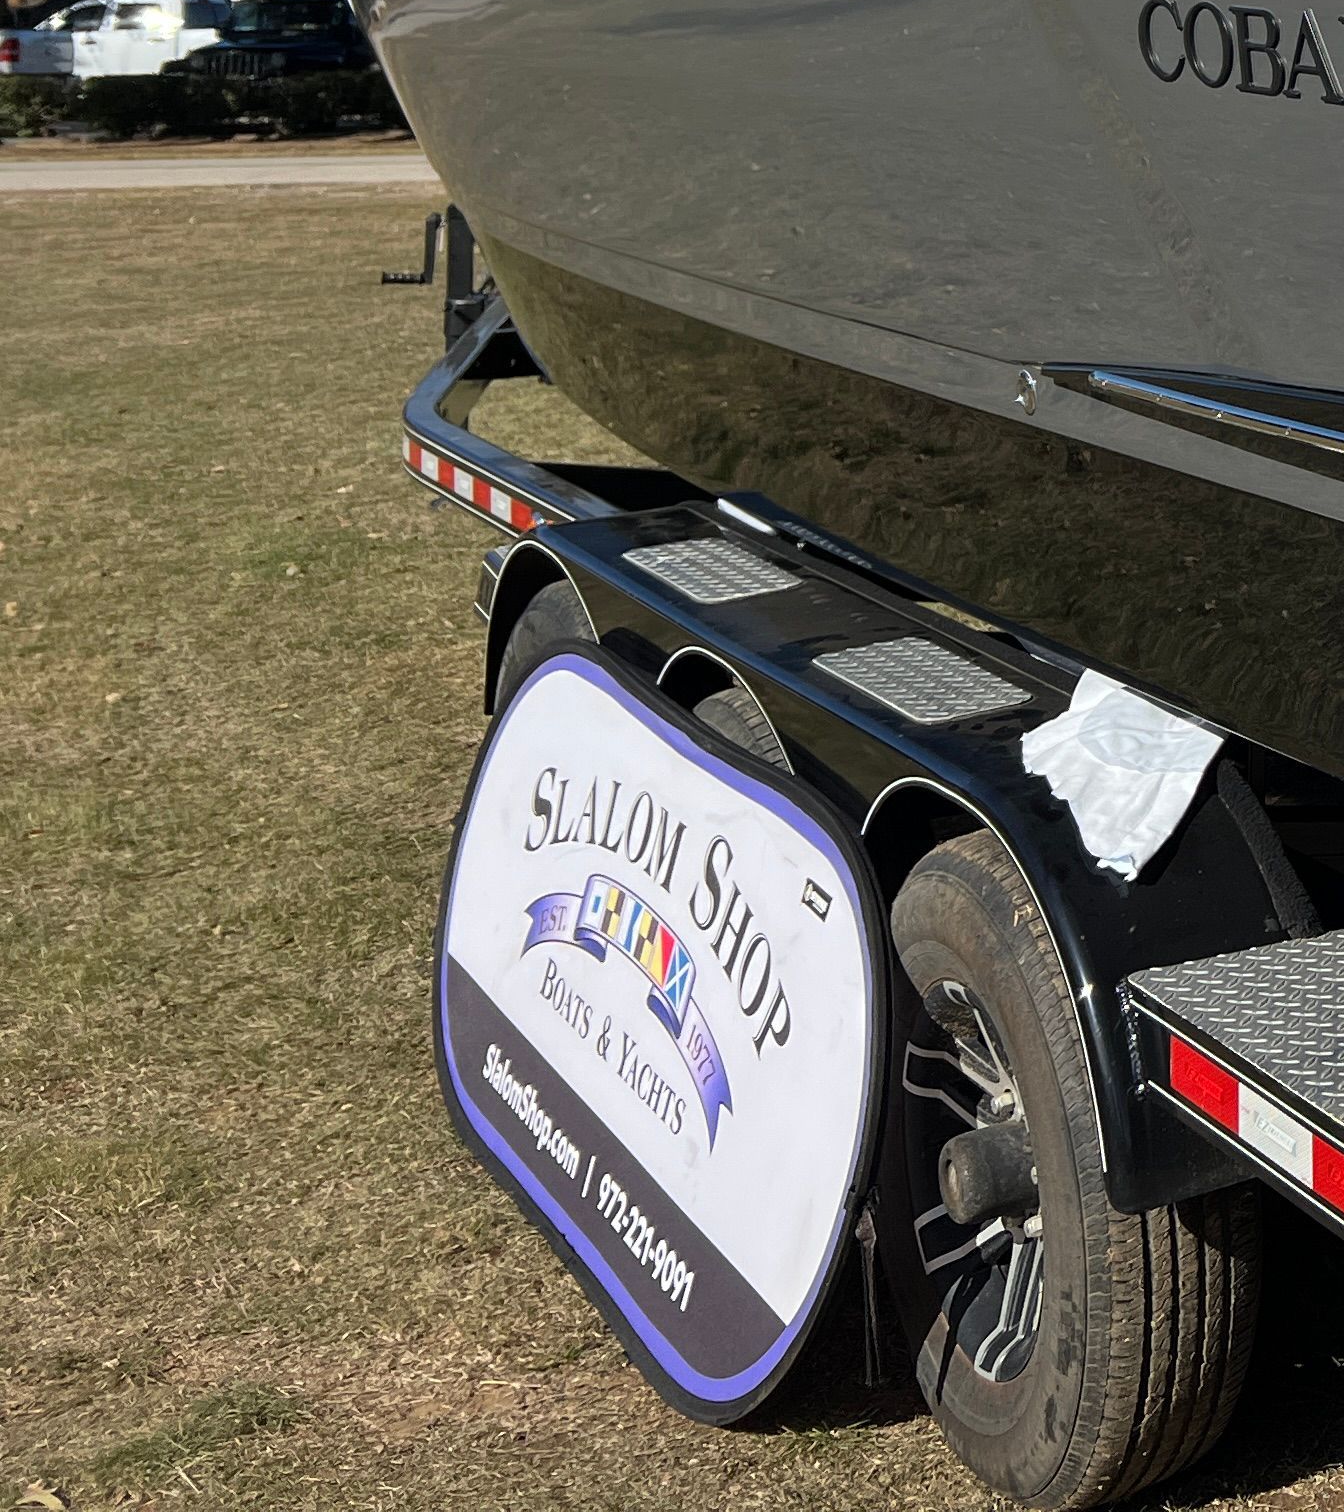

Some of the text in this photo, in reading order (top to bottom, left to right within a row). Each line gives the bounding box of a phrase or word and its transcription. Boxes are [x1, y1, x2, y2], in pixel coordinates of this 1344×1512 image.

[524, 766, 795, 1058] SLALOM SHOP
[537, 904, 568, 935] EST.
[539, 957, 687, 1136] BOATS & YACHTS
[686, 1024, 716, 1087] 1977
[482, 1041, 581, 1180] SlalomShop.com
[596, 1180, 695, 1314] 972-221-9091
